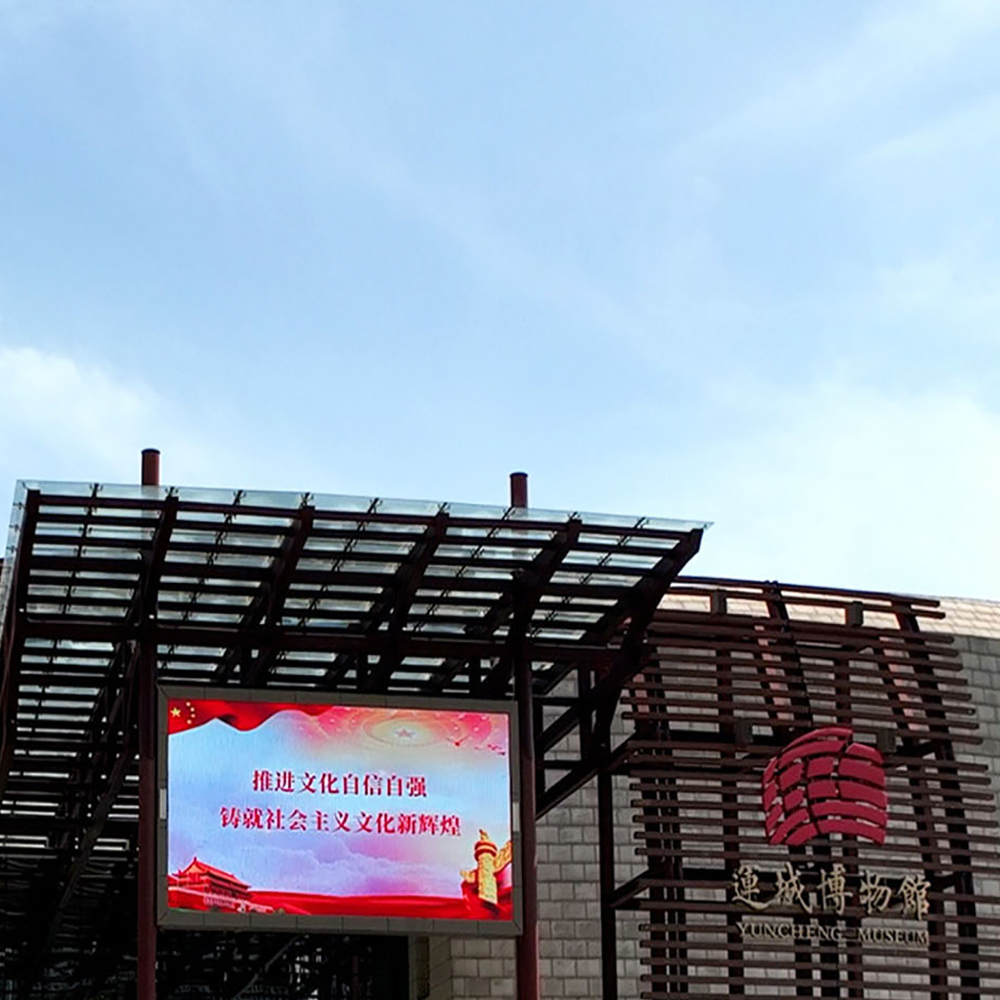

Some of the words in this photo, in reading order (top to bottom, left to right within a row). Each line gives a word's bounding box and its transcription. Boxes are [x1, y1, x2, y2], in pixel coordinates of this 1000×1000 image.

[252, 769, 427, 798] 推进文化自信自强
[219, 806, 462, 837] 铸就社会主义文化新辉煌
[736, 921, 842, 942] YUNCHENG
[857, 928, 930, 946] MUSEUM
